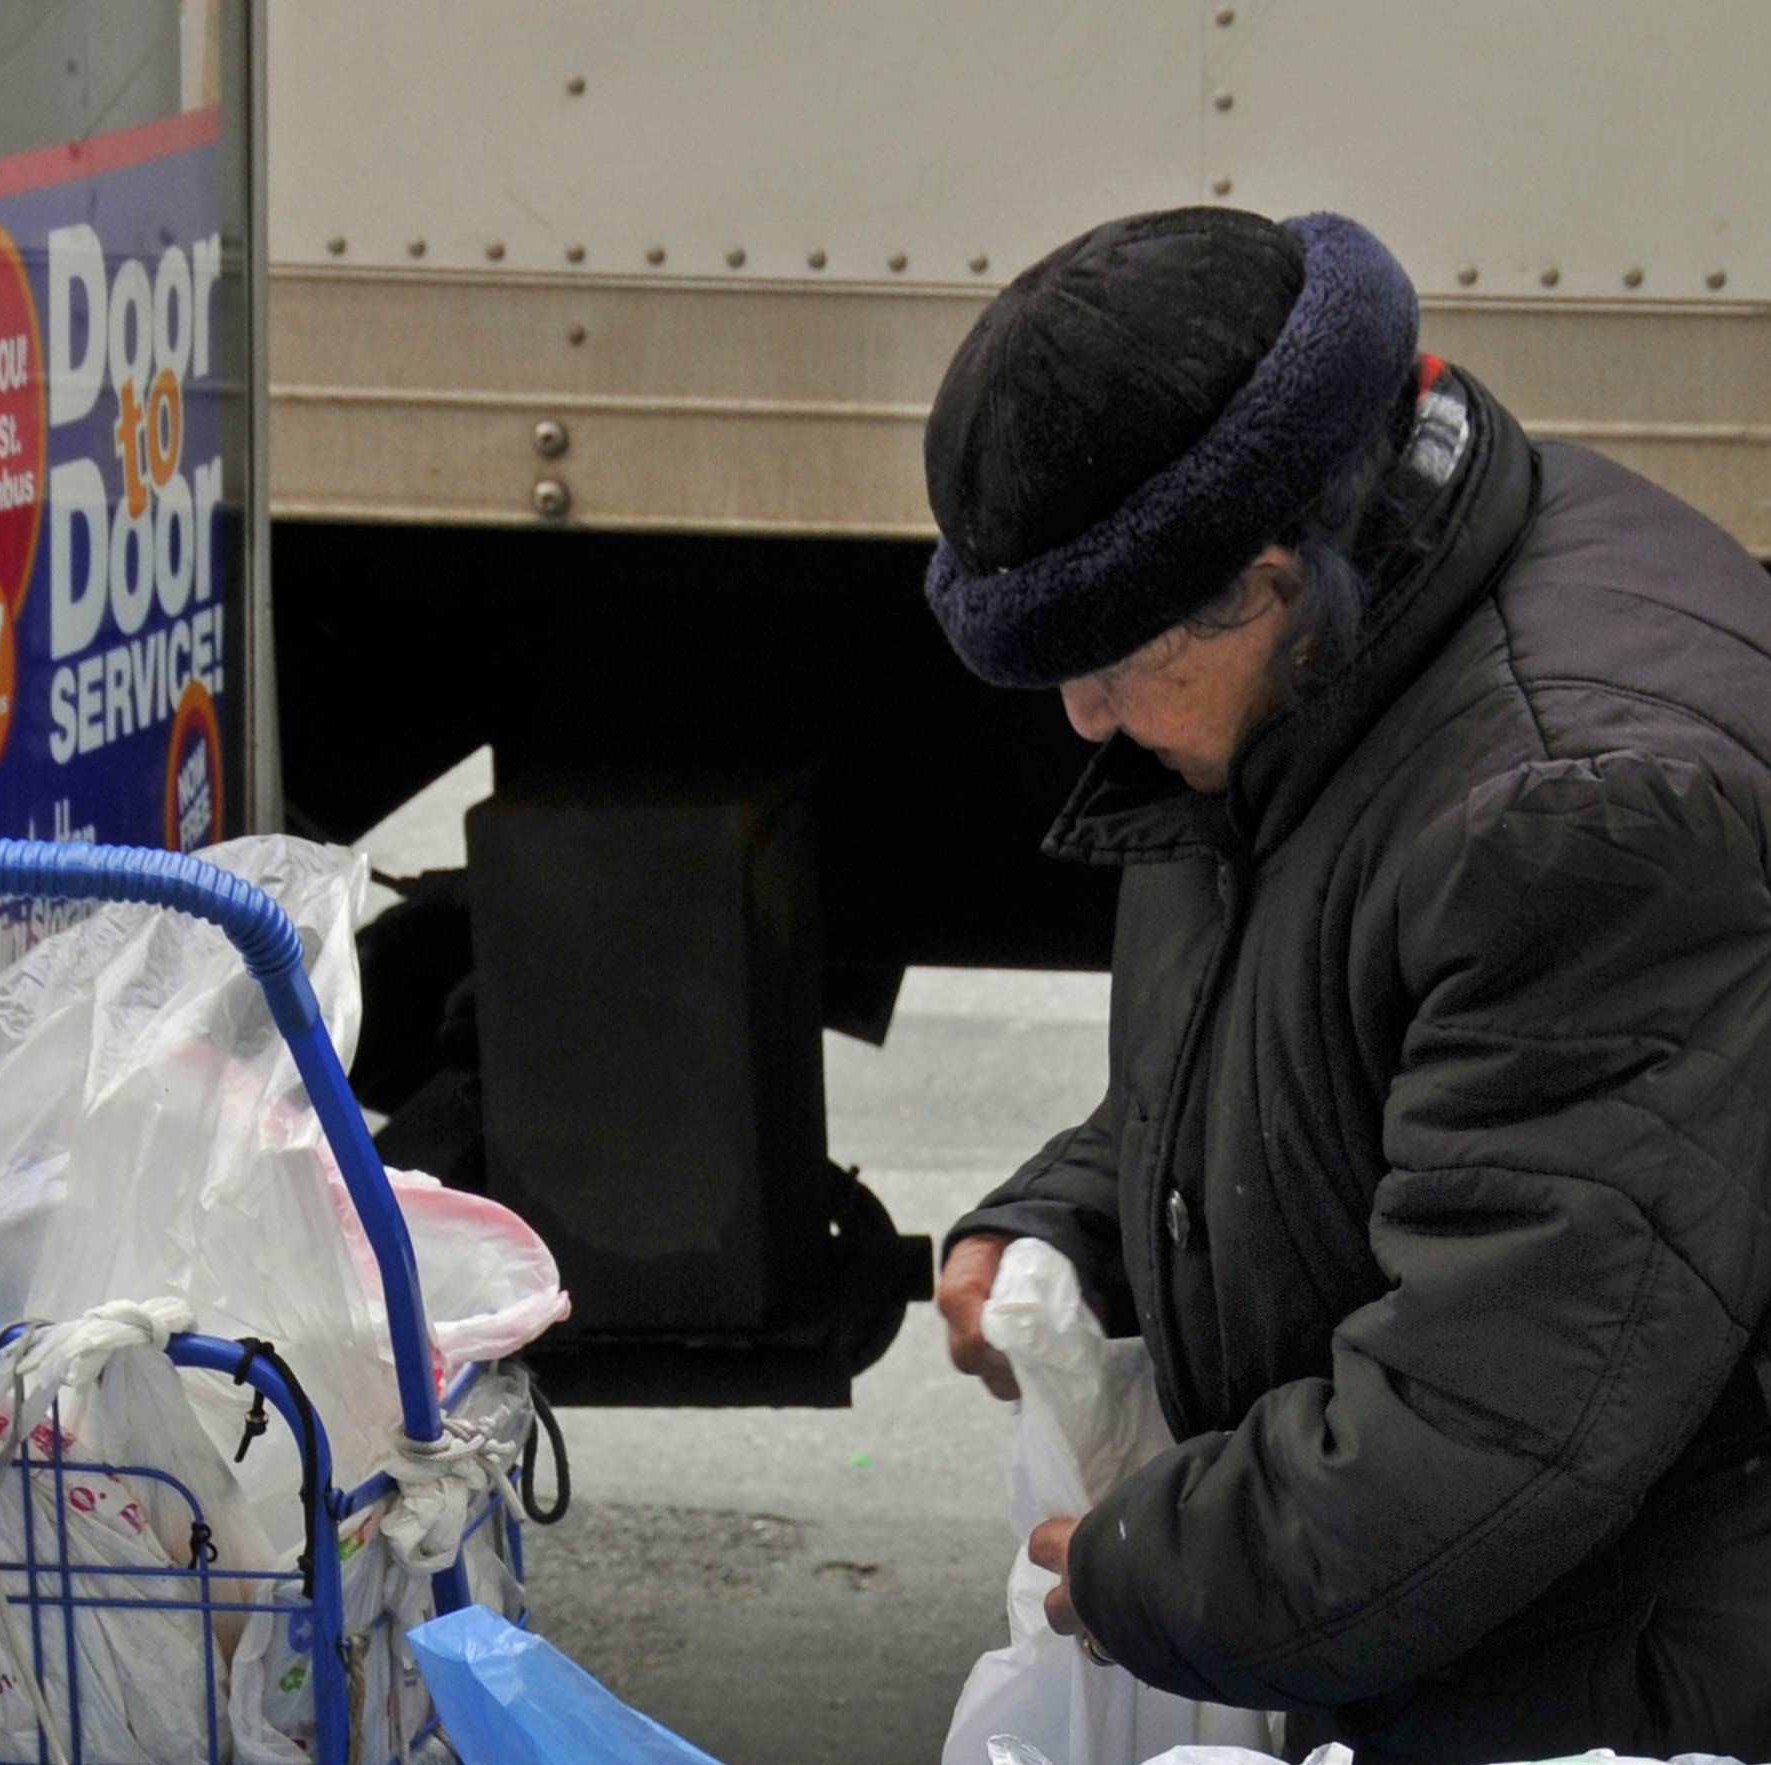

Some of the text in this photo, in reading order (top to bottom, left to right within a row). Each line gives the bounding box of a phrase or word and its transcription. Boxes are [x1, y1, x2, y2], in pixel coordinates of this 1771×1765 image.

[48, 222, 221, 429] Door
[114, 367, 184, 519] to
[48, 455, 224, 662] Door
[48, 603, 225, 766] SERVICE!
